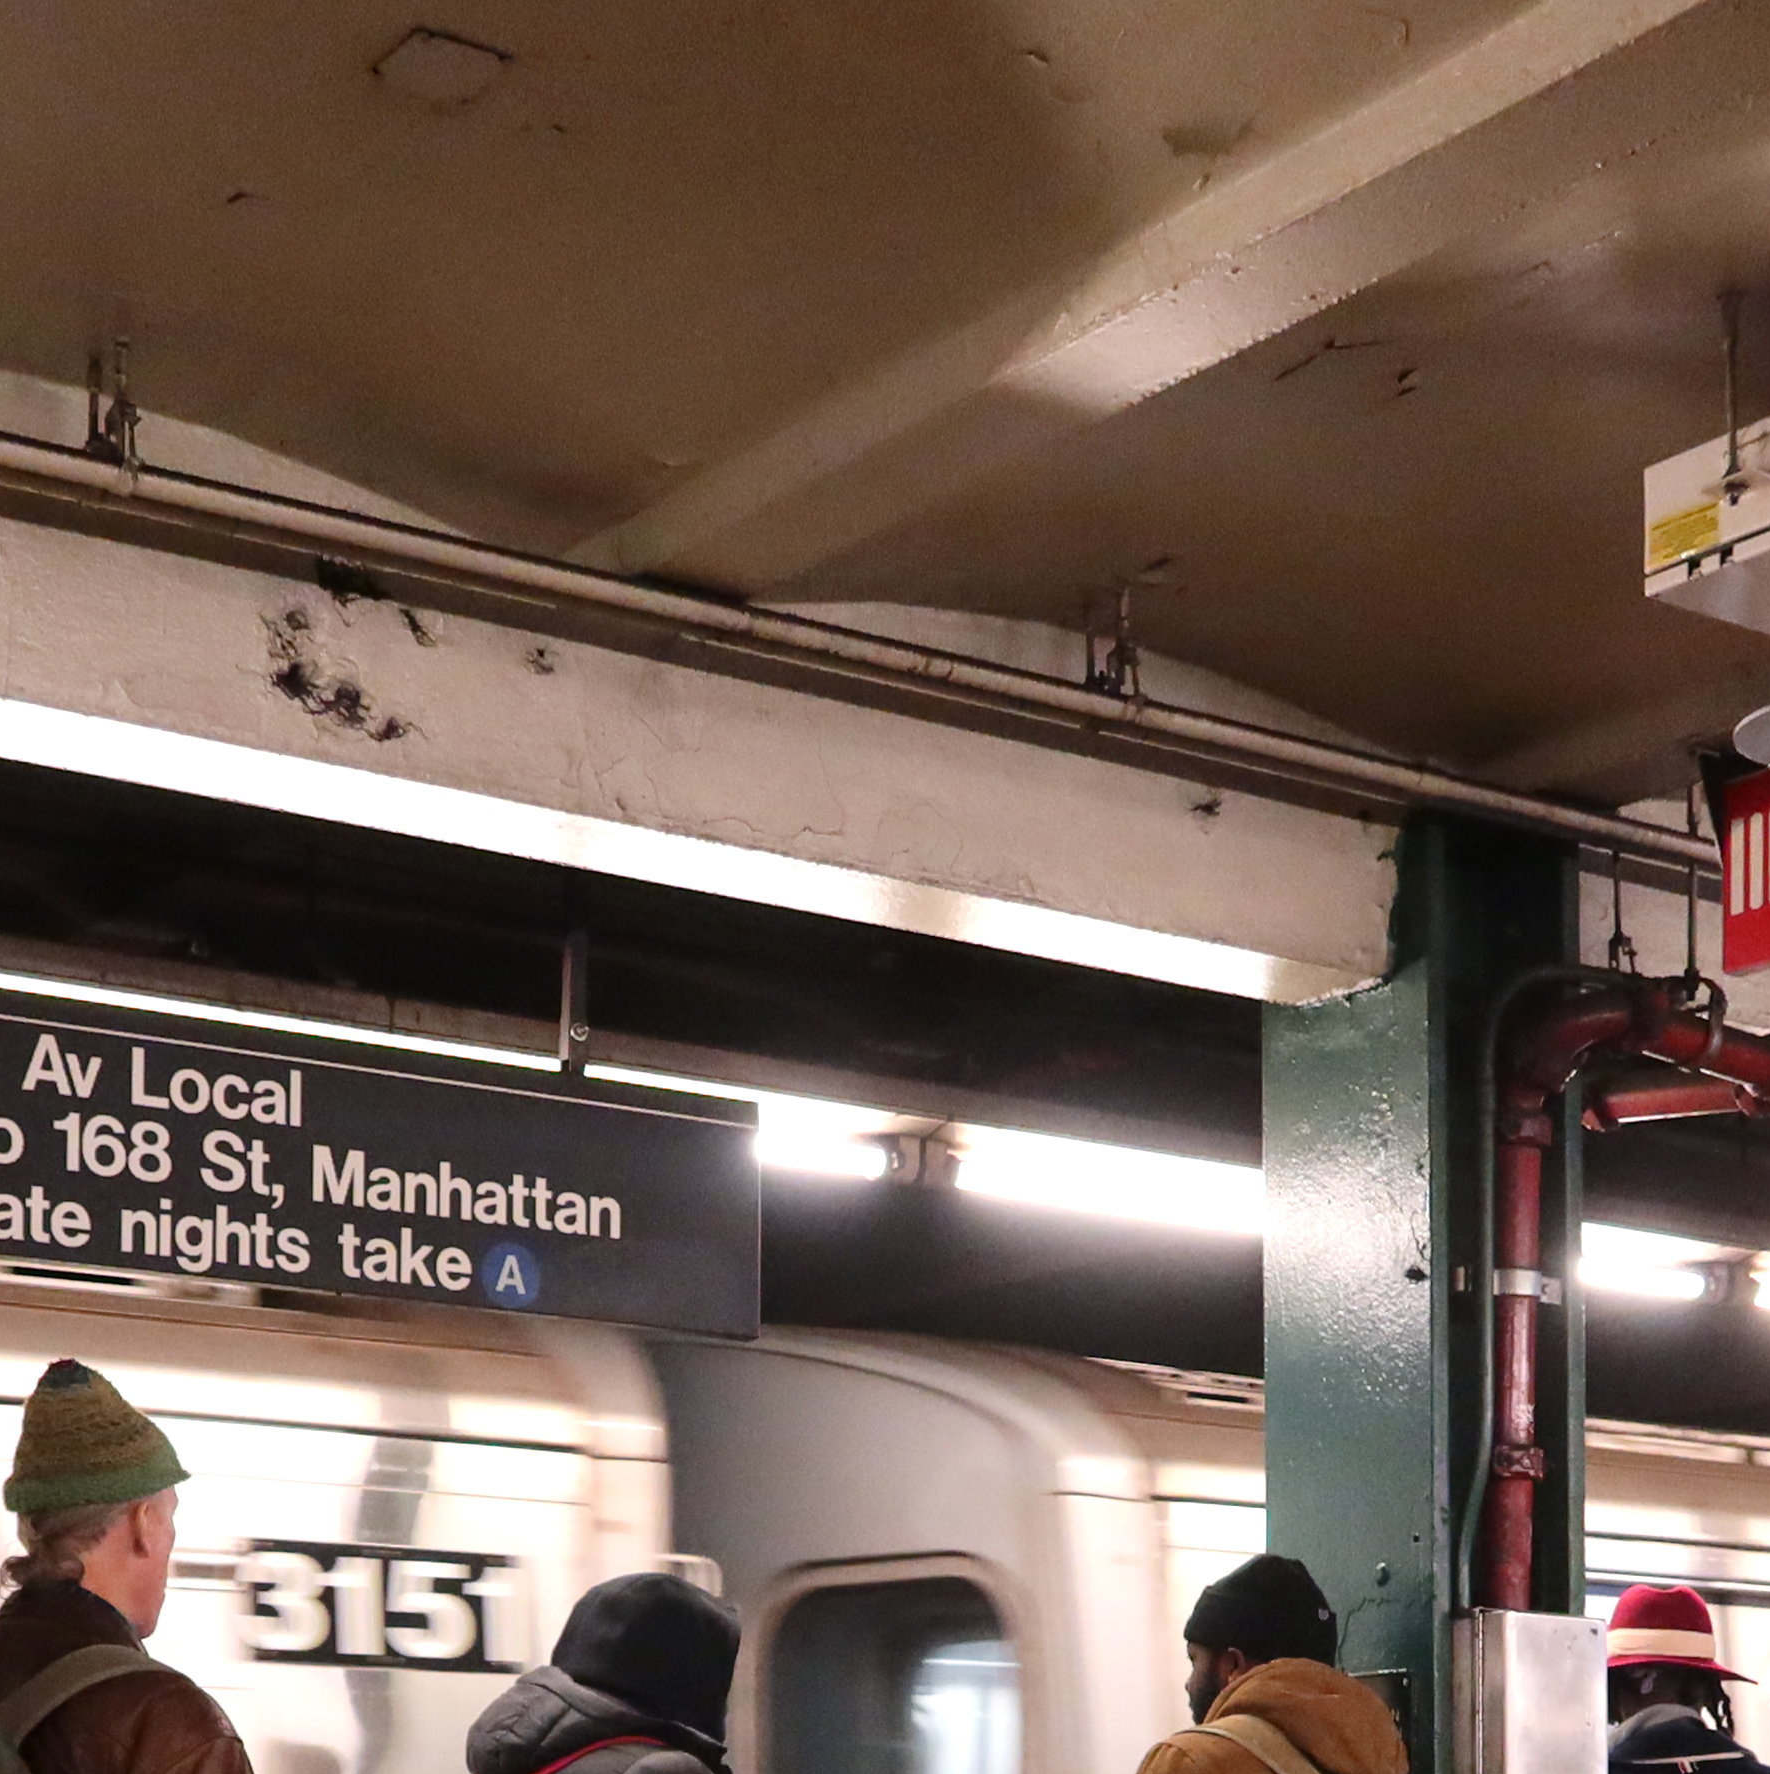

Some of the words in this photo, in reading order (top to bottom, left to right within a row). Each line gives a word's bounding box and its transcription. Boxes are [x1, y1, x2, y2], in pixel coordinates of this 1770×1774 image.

[21, 1033, 103, 1099] Av
[131, 1046, 302, 1127] Local
[53, 1111, 173, 1183] 168
[200, 1129, 286, 1209] St,
[312, 1144, 621, 1240] Manhattan
[120, 1197, 311, 1273] nights
[337, 1223, 473, 1291] take
[495, 1254, 527, 1296] A
[233, 1550, 534, 1663] 3151
